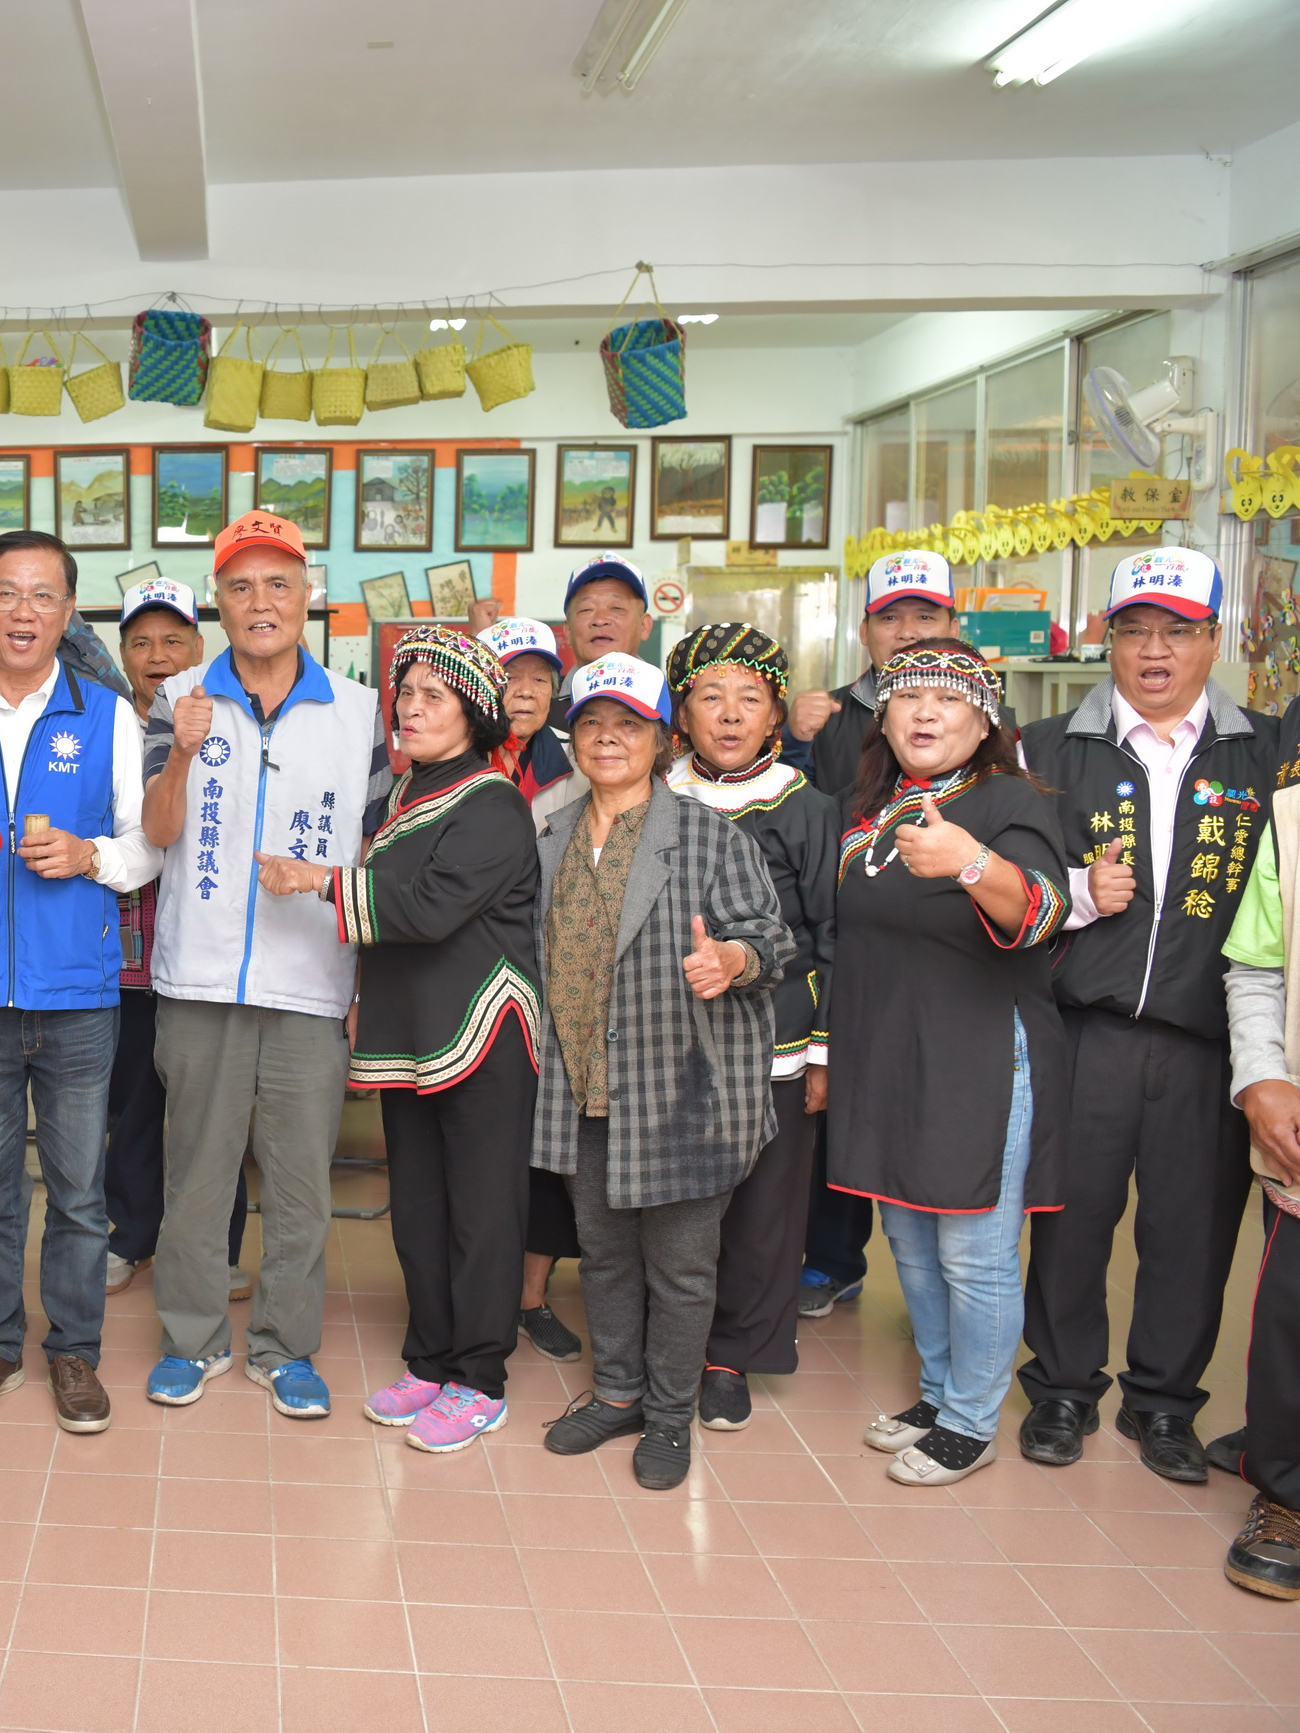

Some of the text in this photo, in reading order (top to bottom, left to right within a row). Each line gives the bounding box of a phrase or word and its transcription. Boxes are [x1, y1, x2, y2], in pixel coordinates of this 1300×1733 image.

[1121, 486, 1182, 503] 教保室
[48, 761, 80, 774] KMT
[196, 777, 223, 900] 南投縣議會
[288, 809, 312, 863] 廖文
[316, 791, 335, 858] 縣議員
[1118, 800, 1137, 866] 南投縣長
[1225, 813, 1252, 893] 仁愛總幹事
[1181, 815, 1226, 919] 戴錦稔
